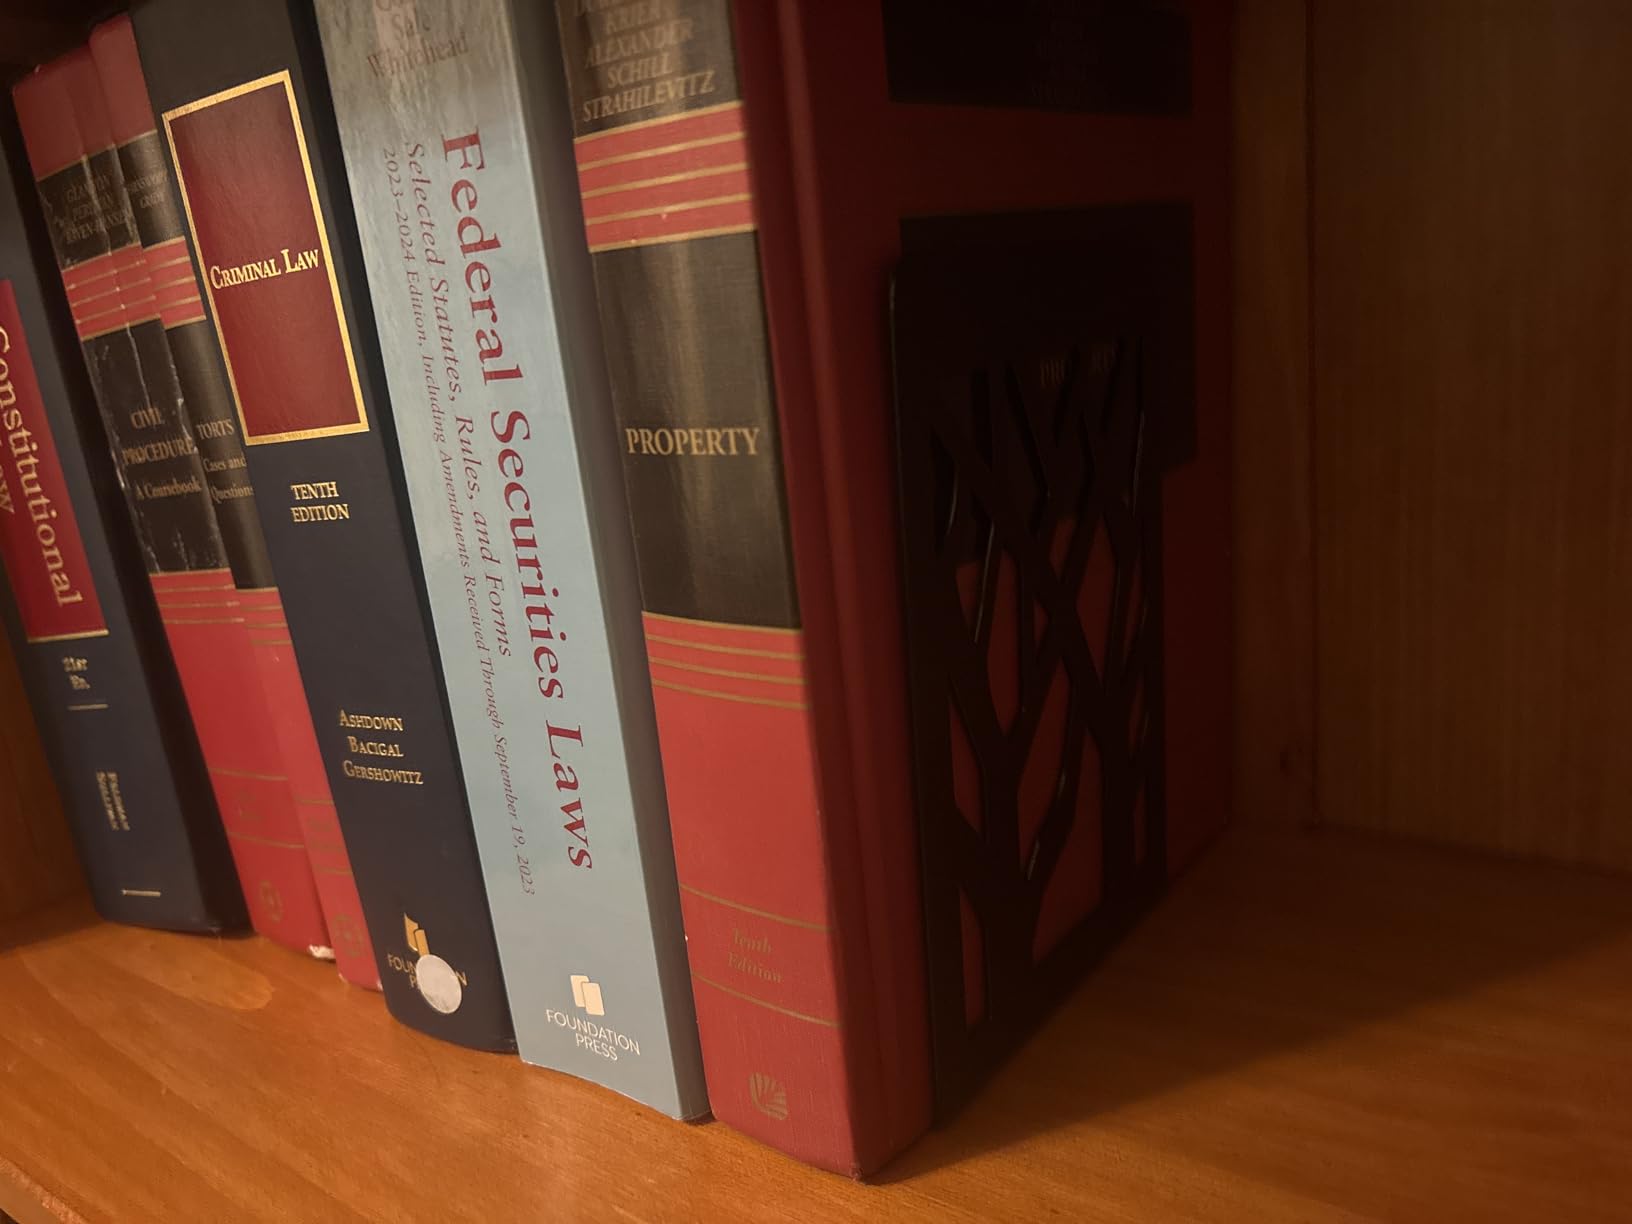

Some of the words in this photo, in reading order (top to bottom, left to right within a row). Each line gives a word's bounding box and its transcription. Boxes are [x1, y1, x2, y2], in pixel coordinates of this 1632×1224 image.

[584, 18, 693, 69] ALEXANDER
[607, 52, 672, 88] SCHILL
[582, 69, 715, 122] STRAHILEVITZ
[404, 142, 445, 265] Selected
[210, 259, 281, 289] CRIMINAL
[281, 249, 319, 274] LAW
[429, 278, 461, 402] Statutes,
[196, 418, 235, 440] TORTS
[624, 427, 760, 456] PROPERTY
[122, 437, 195, 465] PROCEDURE
[456, 415, 482, 501] Rules,
[290, 481, 339, 501] TENTH
[441, 130, 523, 385] Federal
[490, 409, 567, 700] Securities
[546, 720, 592, 869] Laws
[290, 503, 350, 522] EDITION
[474, 511, 501, 565] and
[406, 270, 426, 347] Edition,
[423, 355, 446, 443] Including
[439, 450, 470, 568] Amendments
[464, 575, 490, 652] Received
[480, 659, 504, 731] Through
[495, 734, 519, 820] September
[517, 854, 536, 896] 2023
[485, 573, 511, 658] Forms
[339, 709, 404, 731] ASHDOWN
[347, 736, 404, 758] BACIGAL
[342, 759, 424, 785] GERSHOWITZ
[387, 952, 468, 988] FOUNN
[727, 951, 783, 983] Edition
[545, 1008, 641, 1056] FOUNDATION
[575, 1032, 618, 1061] PRESS
